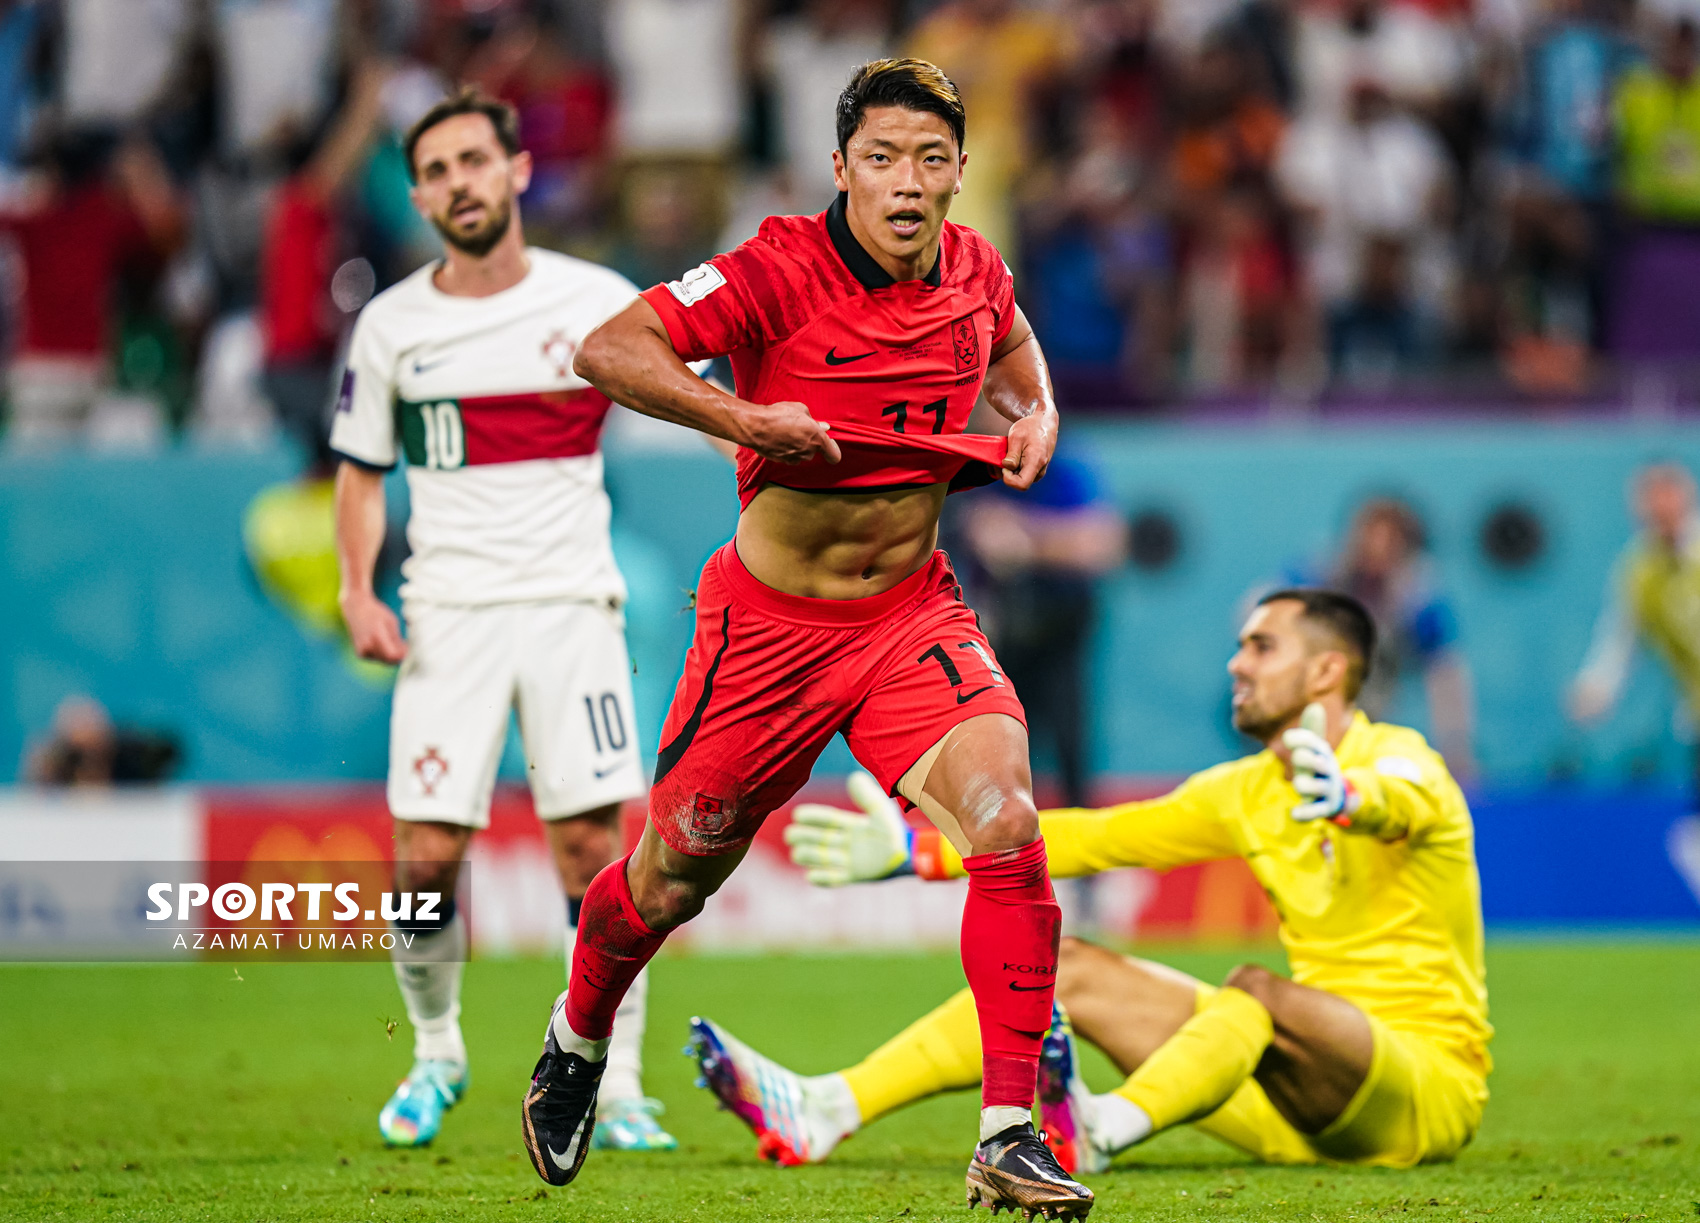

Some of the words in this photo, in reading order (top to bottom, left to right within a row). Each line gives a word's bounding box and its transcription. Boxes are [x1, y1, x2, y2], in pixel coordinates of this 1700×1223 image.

[955, 371, 979, 387] KOREA
[420, 401, 465, 470] 10
[881, 397, 948, 435] 11
[917, 640, 1005, 688] 11
[584, 692, 628, 754] 10
[1003, 963, 1057, 974] KORE
